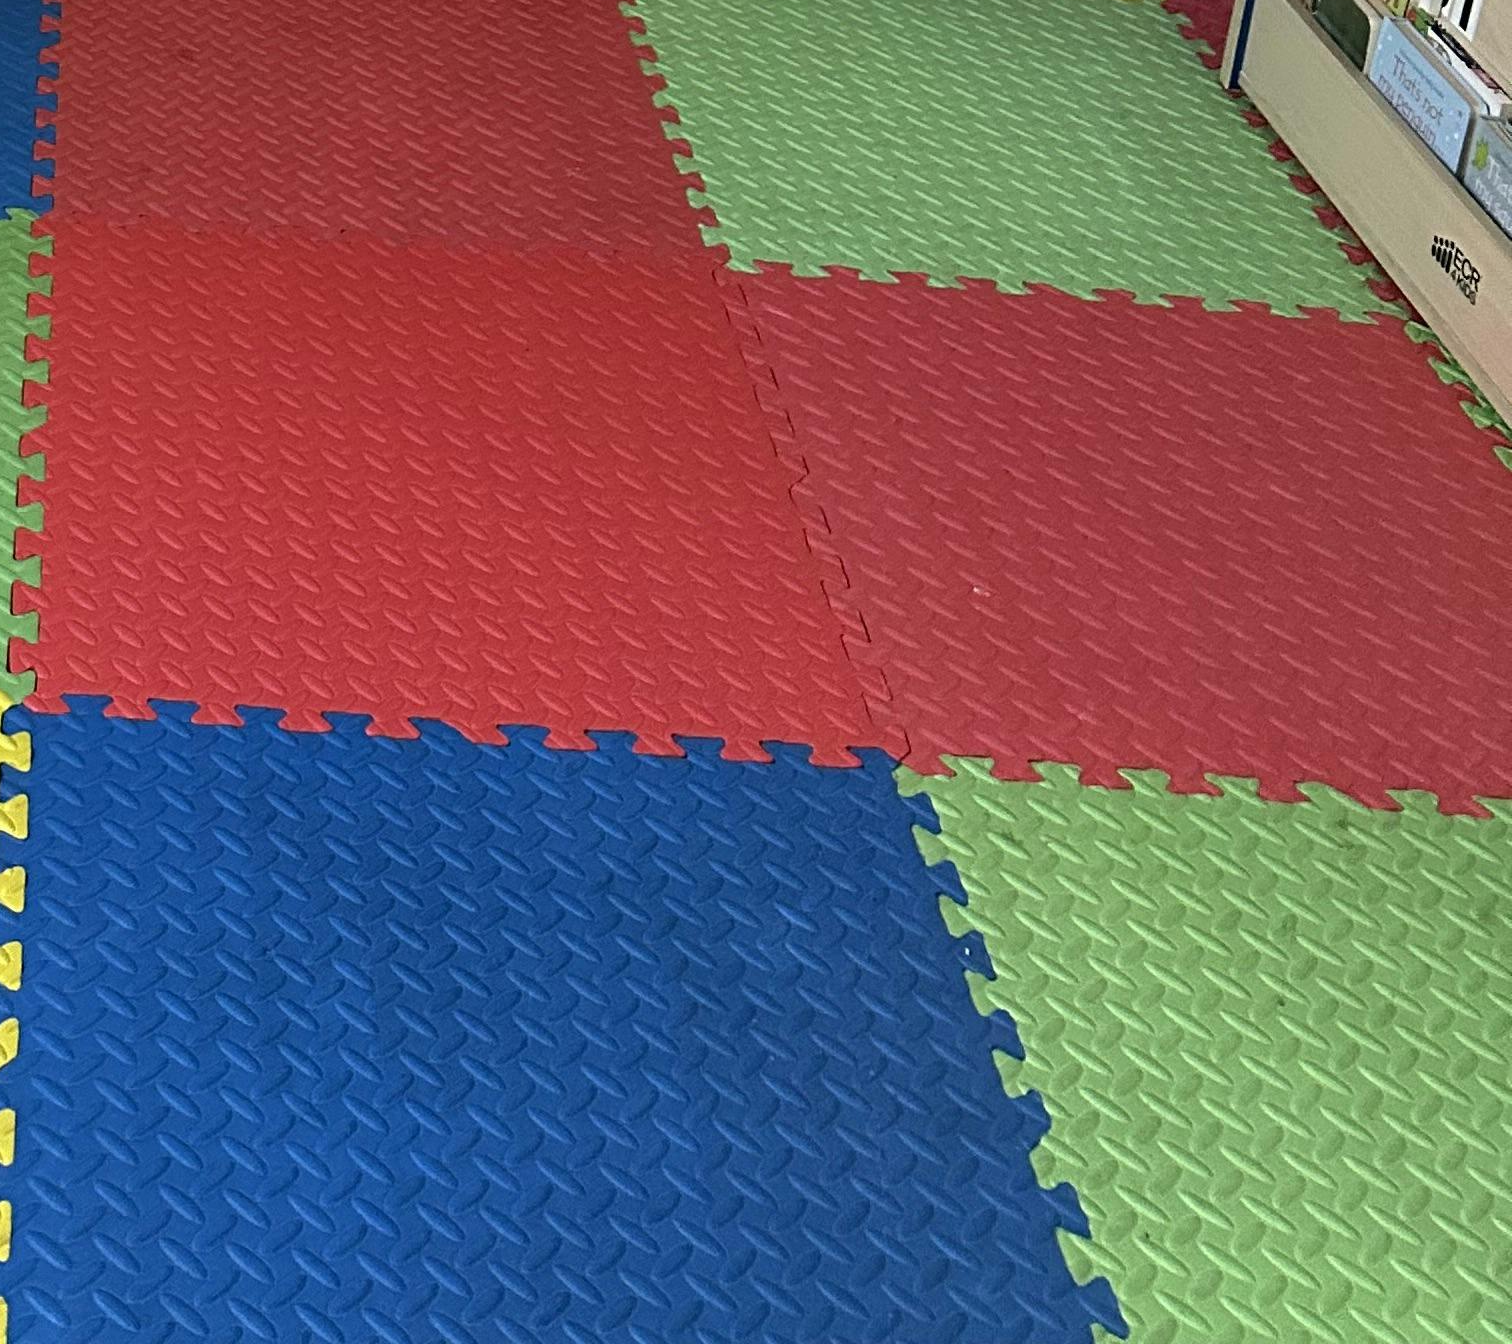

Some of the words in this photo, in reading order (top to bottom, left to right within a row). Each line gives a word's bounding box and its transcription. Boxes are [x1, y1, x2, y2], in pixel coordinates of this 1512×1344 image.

[1393, 55, 1421, 103] That's
[1422, 95, 1445, 128] not
[1454, 247, 1481, 293] ECR
[1456, 275, 1477, 306] KIDS
